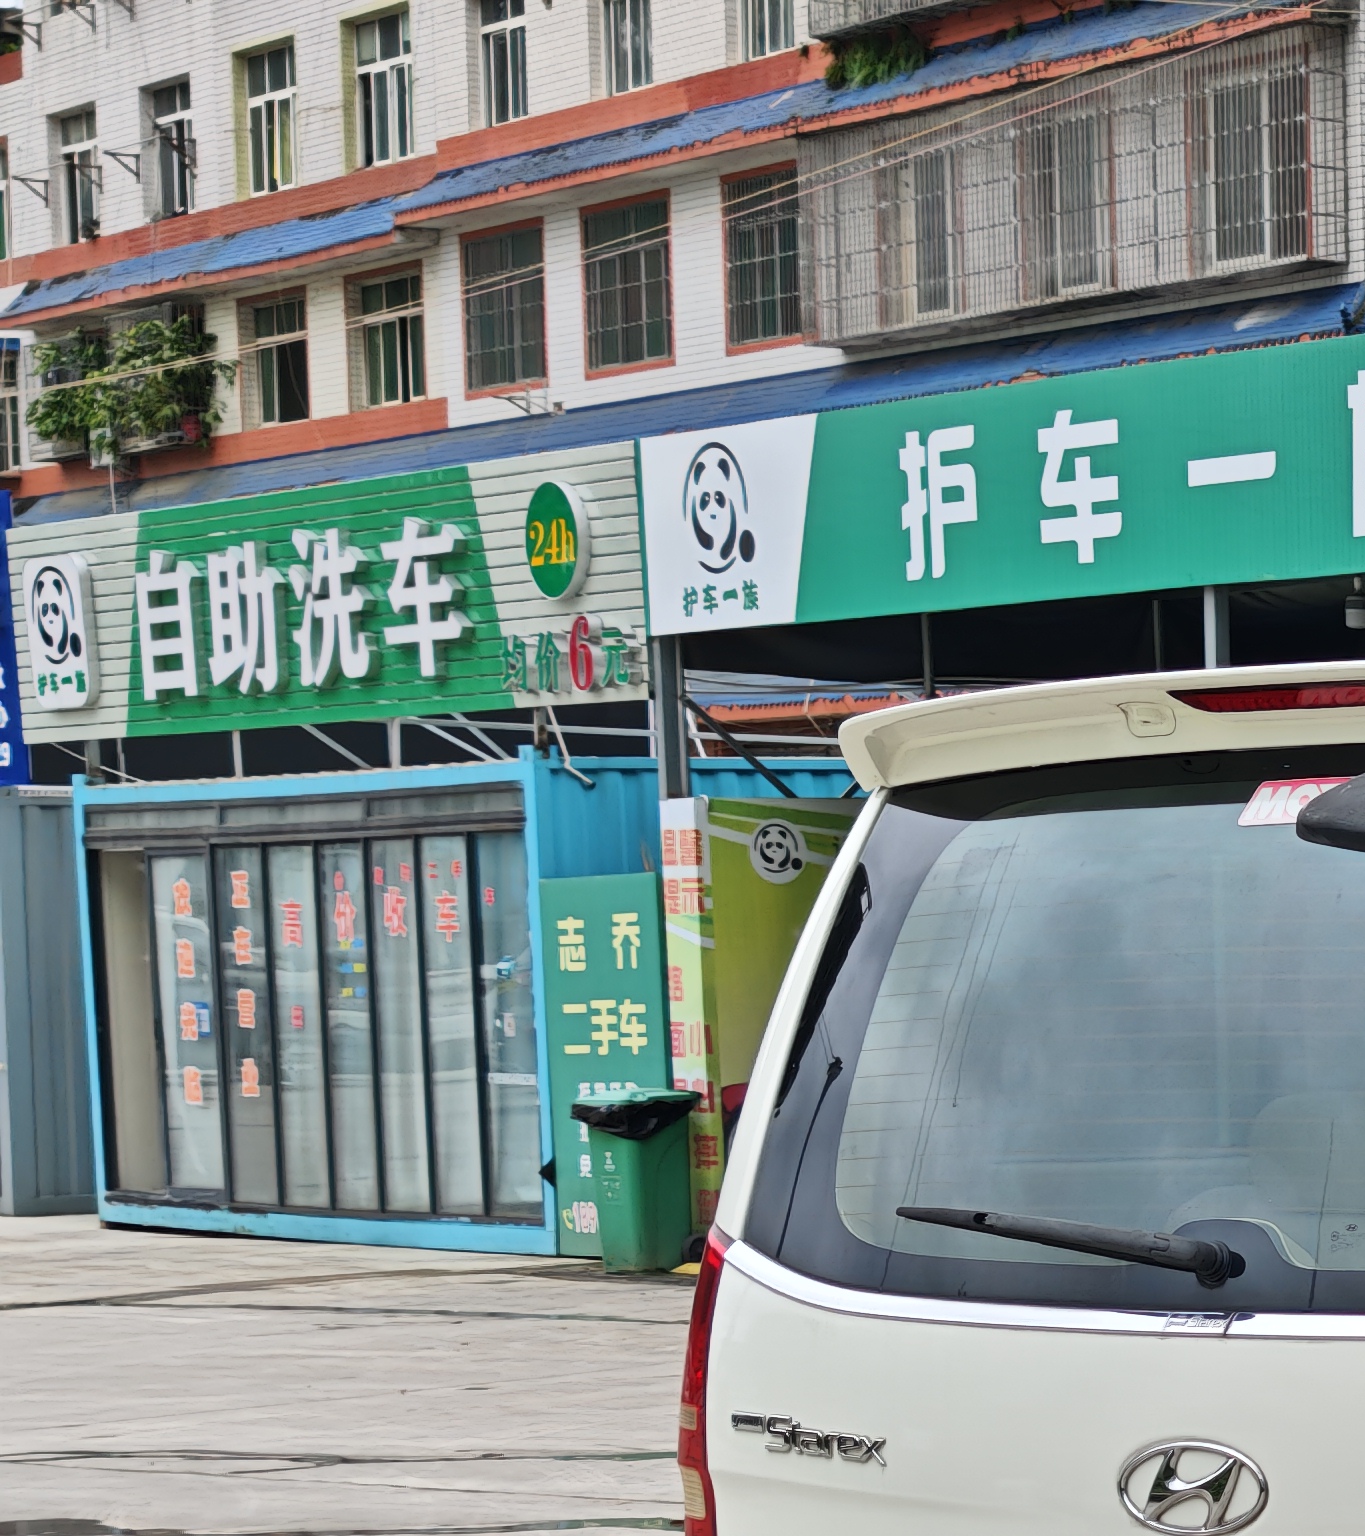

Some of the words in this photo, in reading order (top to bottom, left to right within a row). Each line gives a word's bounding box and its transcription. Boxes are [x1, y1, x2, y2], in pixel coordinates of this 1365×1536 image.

[529, 518, 576, 567] 24h
[135, 517, 468, 701] 自助洗车
[502, 616, 630, 692] 均价6元
[556, 912, 642, 972] 志乔
[562, 998, 648, 1056] 二手车
[764, 1413, 887, 1467] Starex
